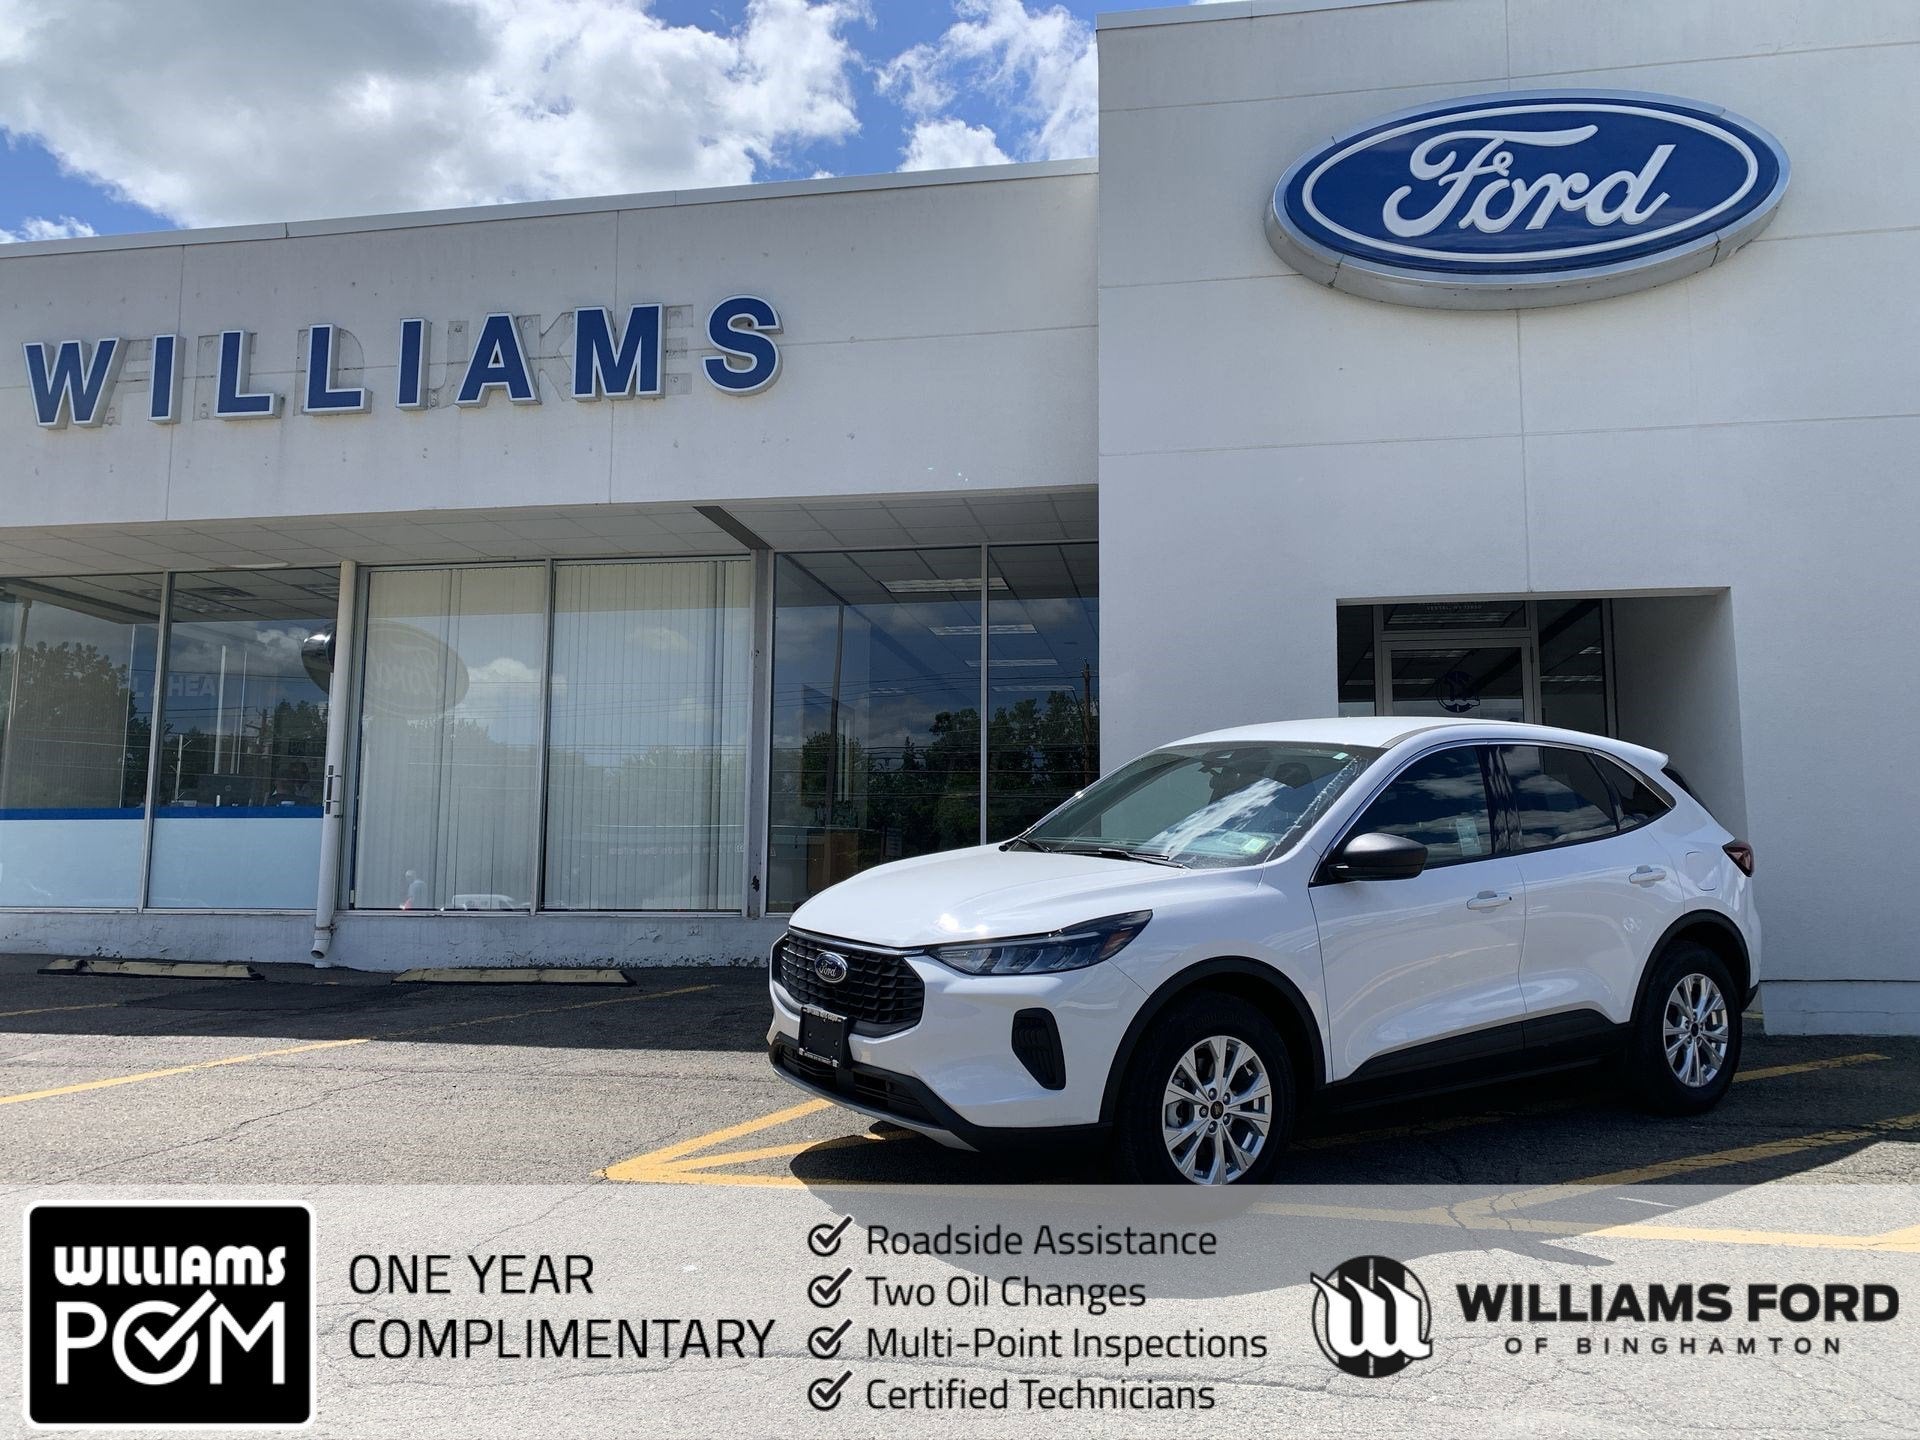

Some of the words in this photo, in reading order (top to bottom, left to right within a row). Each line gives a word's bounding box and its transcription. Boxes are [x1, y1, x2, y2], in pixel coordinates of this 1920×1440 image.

[1382, 123, 1677, 239] Ford
[22, 293, 784, 430] WILLIAMS
[819, 959, 838, 978] Ford
